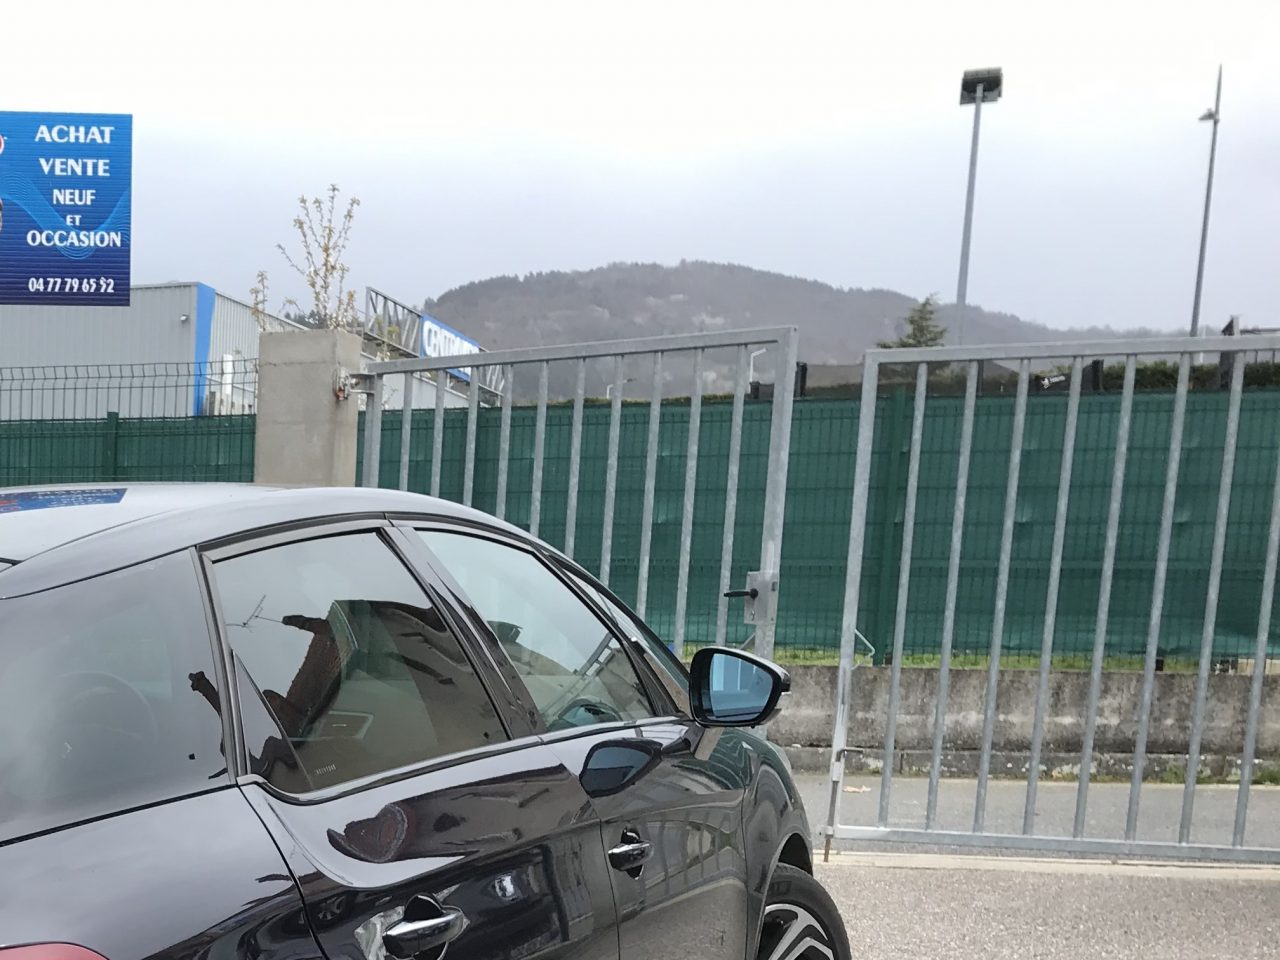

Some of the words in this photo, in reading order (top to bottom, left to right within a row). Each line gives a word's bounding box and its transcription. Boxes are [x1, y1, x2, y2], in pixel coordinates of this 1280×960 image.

[34, 124, 115, 144] ACHAT
[38, 157, 111, 177] VENTE
[52, 188, 96, 206] NEUF
[65, 214, 82, 226] ET
[26, 229, 122, 248] OCCASION
[28, 277, 45, 293] 04
[46, 277, 63, 293] 77
[64, 277, 80, 293] 79
[81, 278, 97, 293] 65
